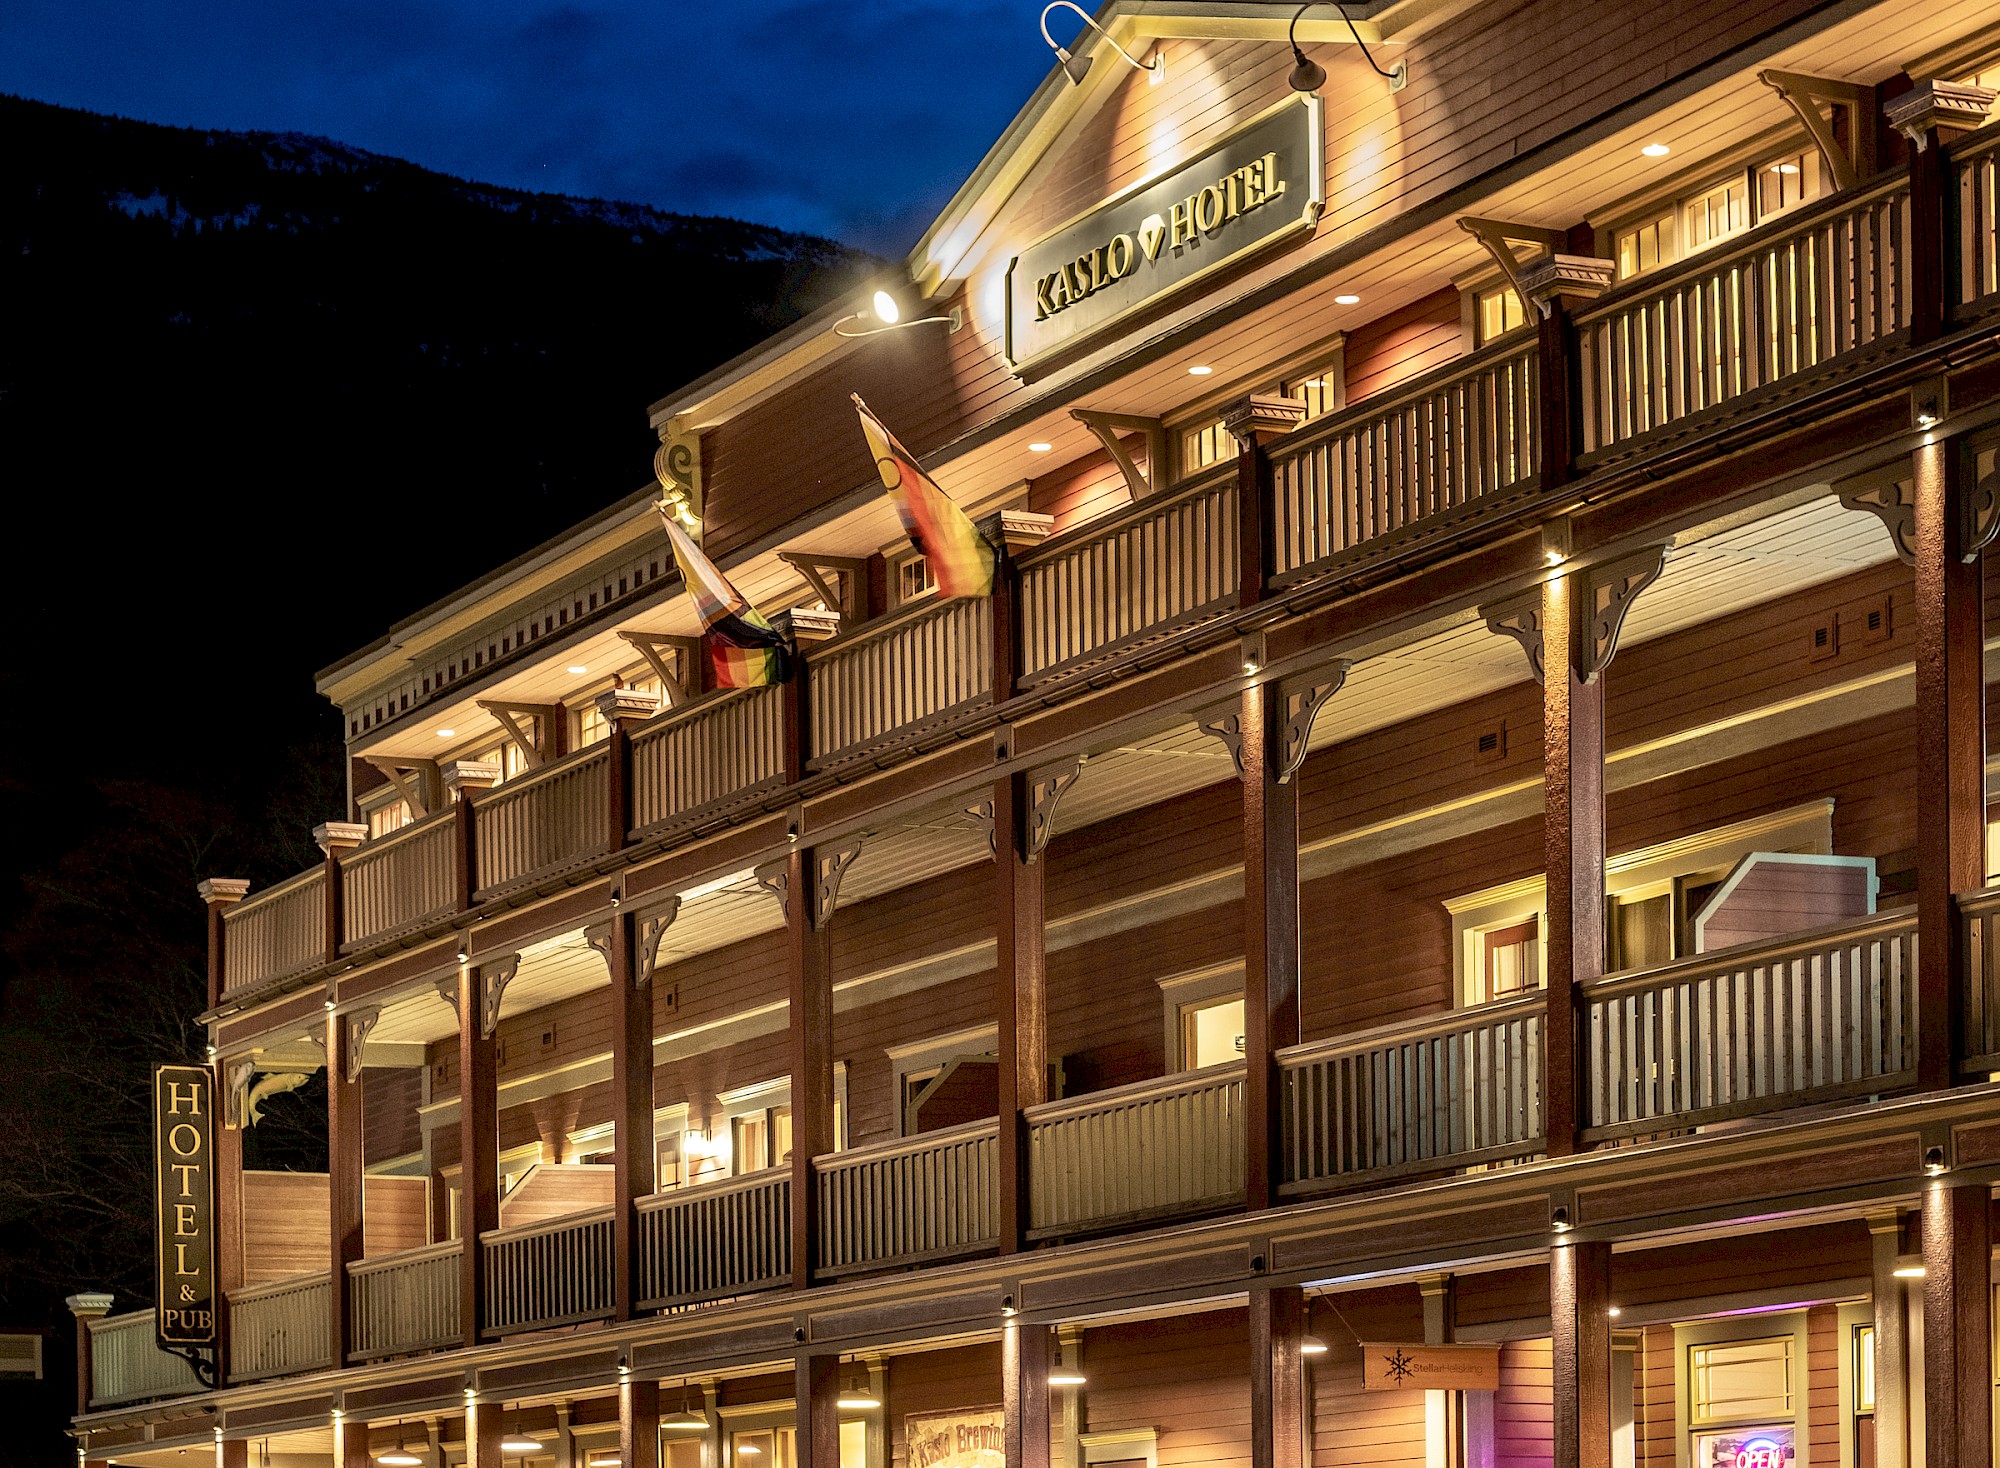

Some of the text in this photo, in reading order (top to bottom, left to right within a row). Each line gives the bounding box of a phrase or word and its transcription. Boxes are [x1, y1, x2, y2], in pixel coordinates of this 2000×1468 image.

[1033, 152, 1286, 321] KASLO HOTEL
[167, 1081, 202, 1276] HOTEL
[179, 1284, 196, 1302] &
[165, 1309, 212, 1329] PUB
[916, 1432, 950, 1468] Kaslo
[1736, 1448, 1781, 1468] OPEN
